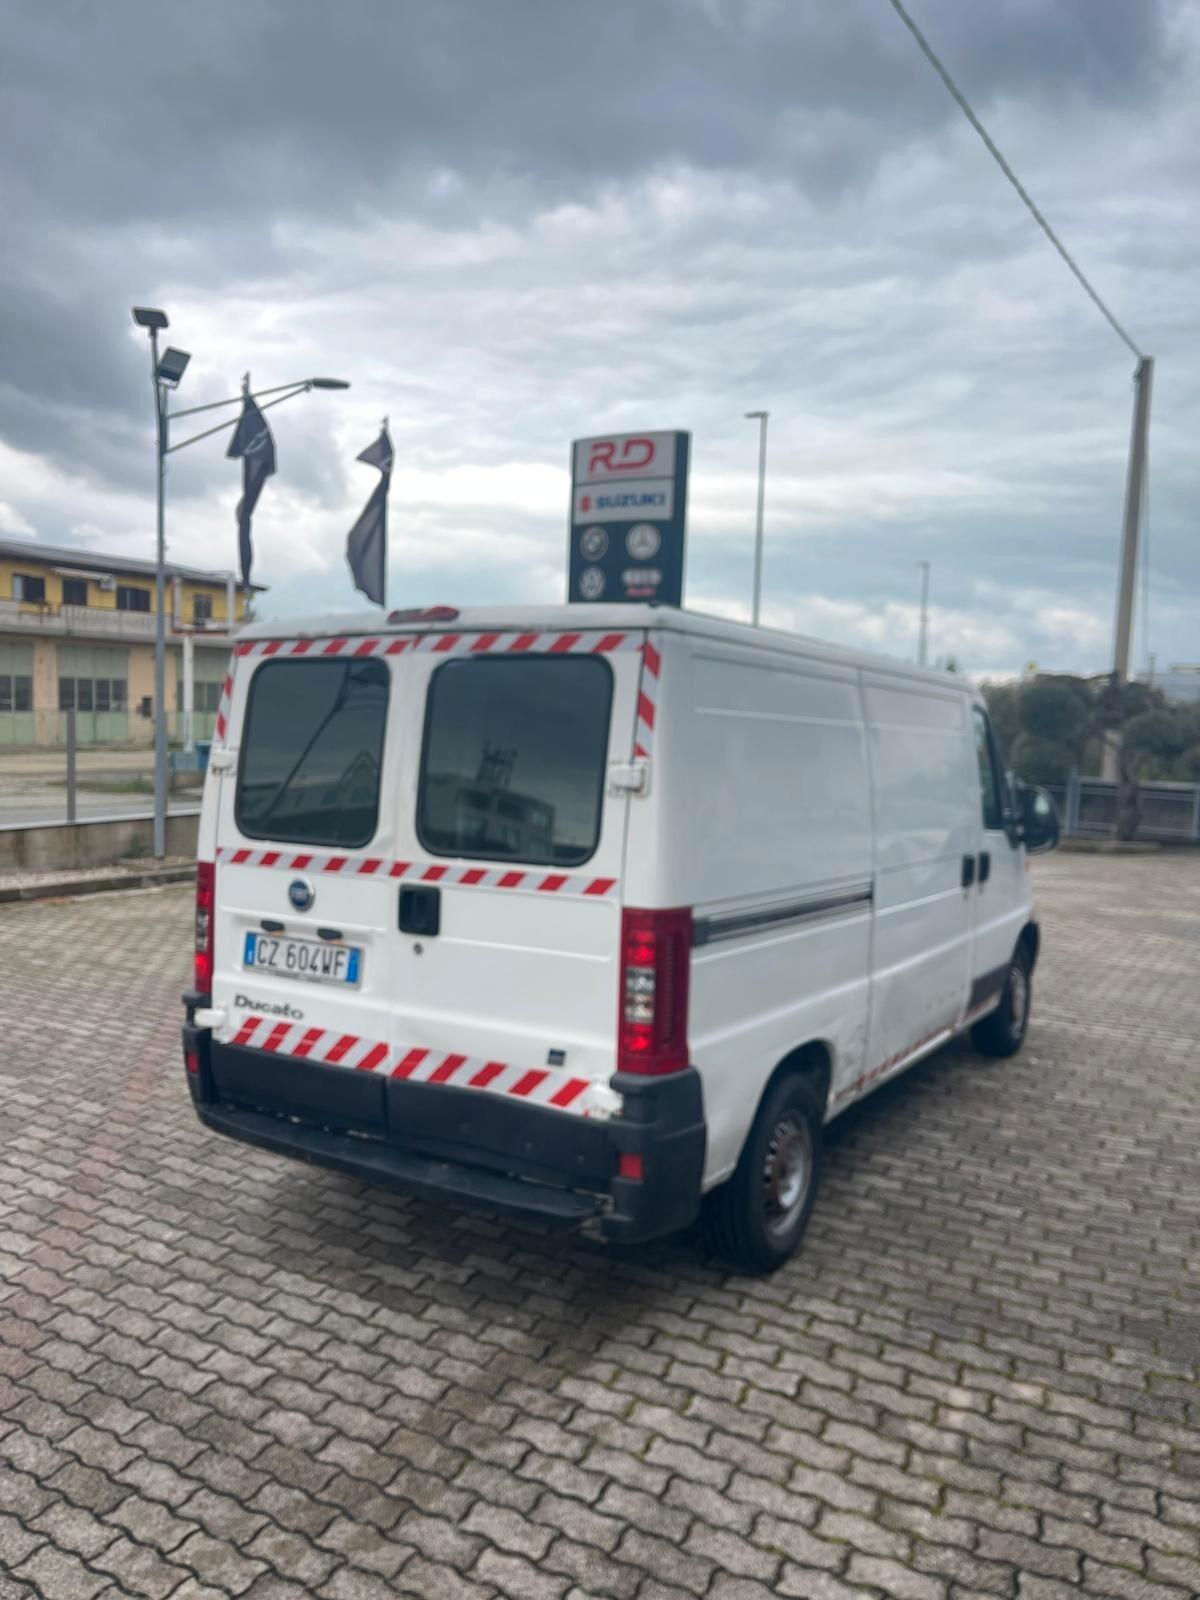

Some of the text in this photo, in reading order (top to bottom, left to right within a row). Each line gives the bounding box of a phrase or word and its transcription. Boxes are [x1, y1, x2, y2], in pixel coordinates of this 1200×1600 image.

[589, 438, 656, 473] RD
[596, 493, 665, 509] SUZUKI
[257, 940, 280, 966] CZ
[285, 944, 346, 976] 604WF
[234, 994, 304, 1019] Ducato
